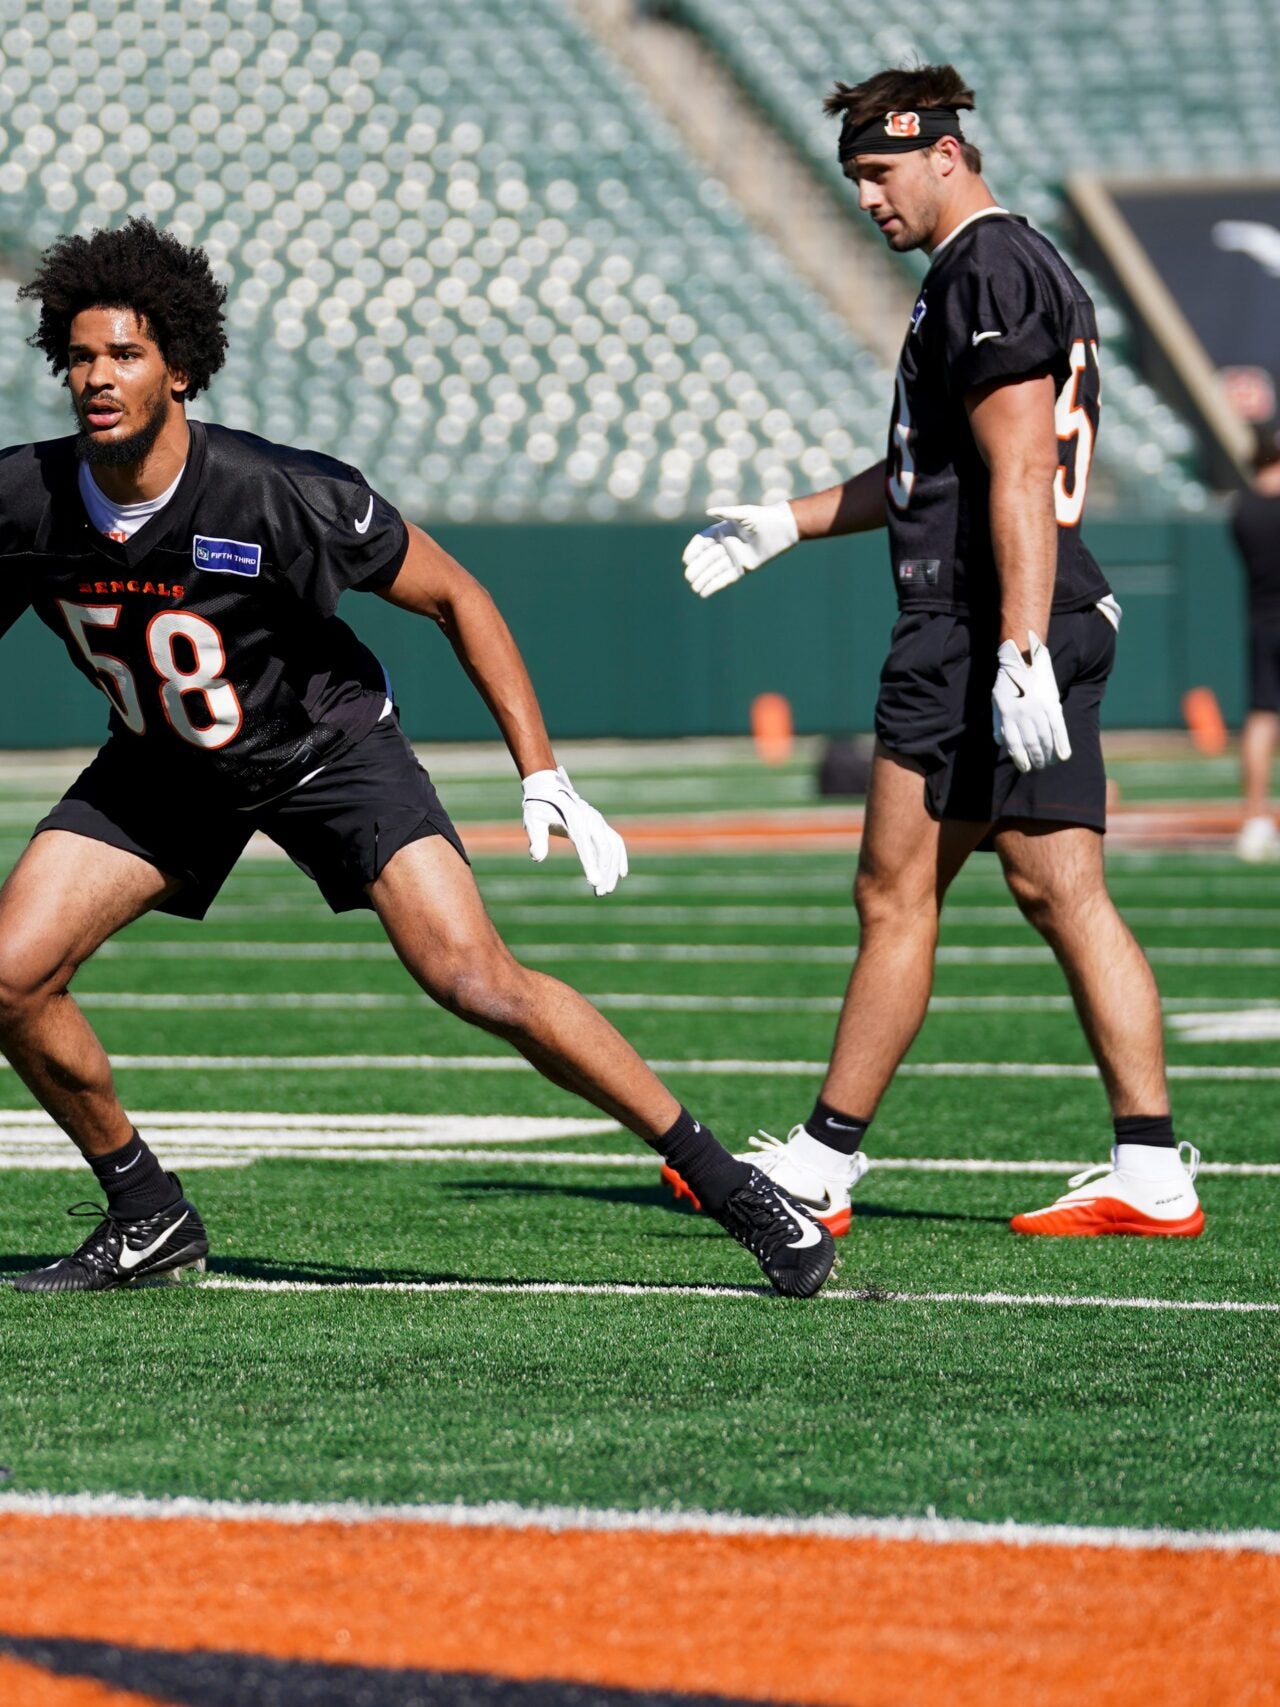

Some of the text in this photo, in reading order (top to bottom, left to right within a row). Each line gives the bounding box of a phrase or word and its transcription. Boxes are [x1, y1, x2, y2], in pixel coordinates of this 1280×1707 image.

[210, 551, 233, 561] FIFTH
[234, 554, 257, 565] THIRD
[79, 580, 185, 598] BENGALS
[55, 599, 244, 749] 58
